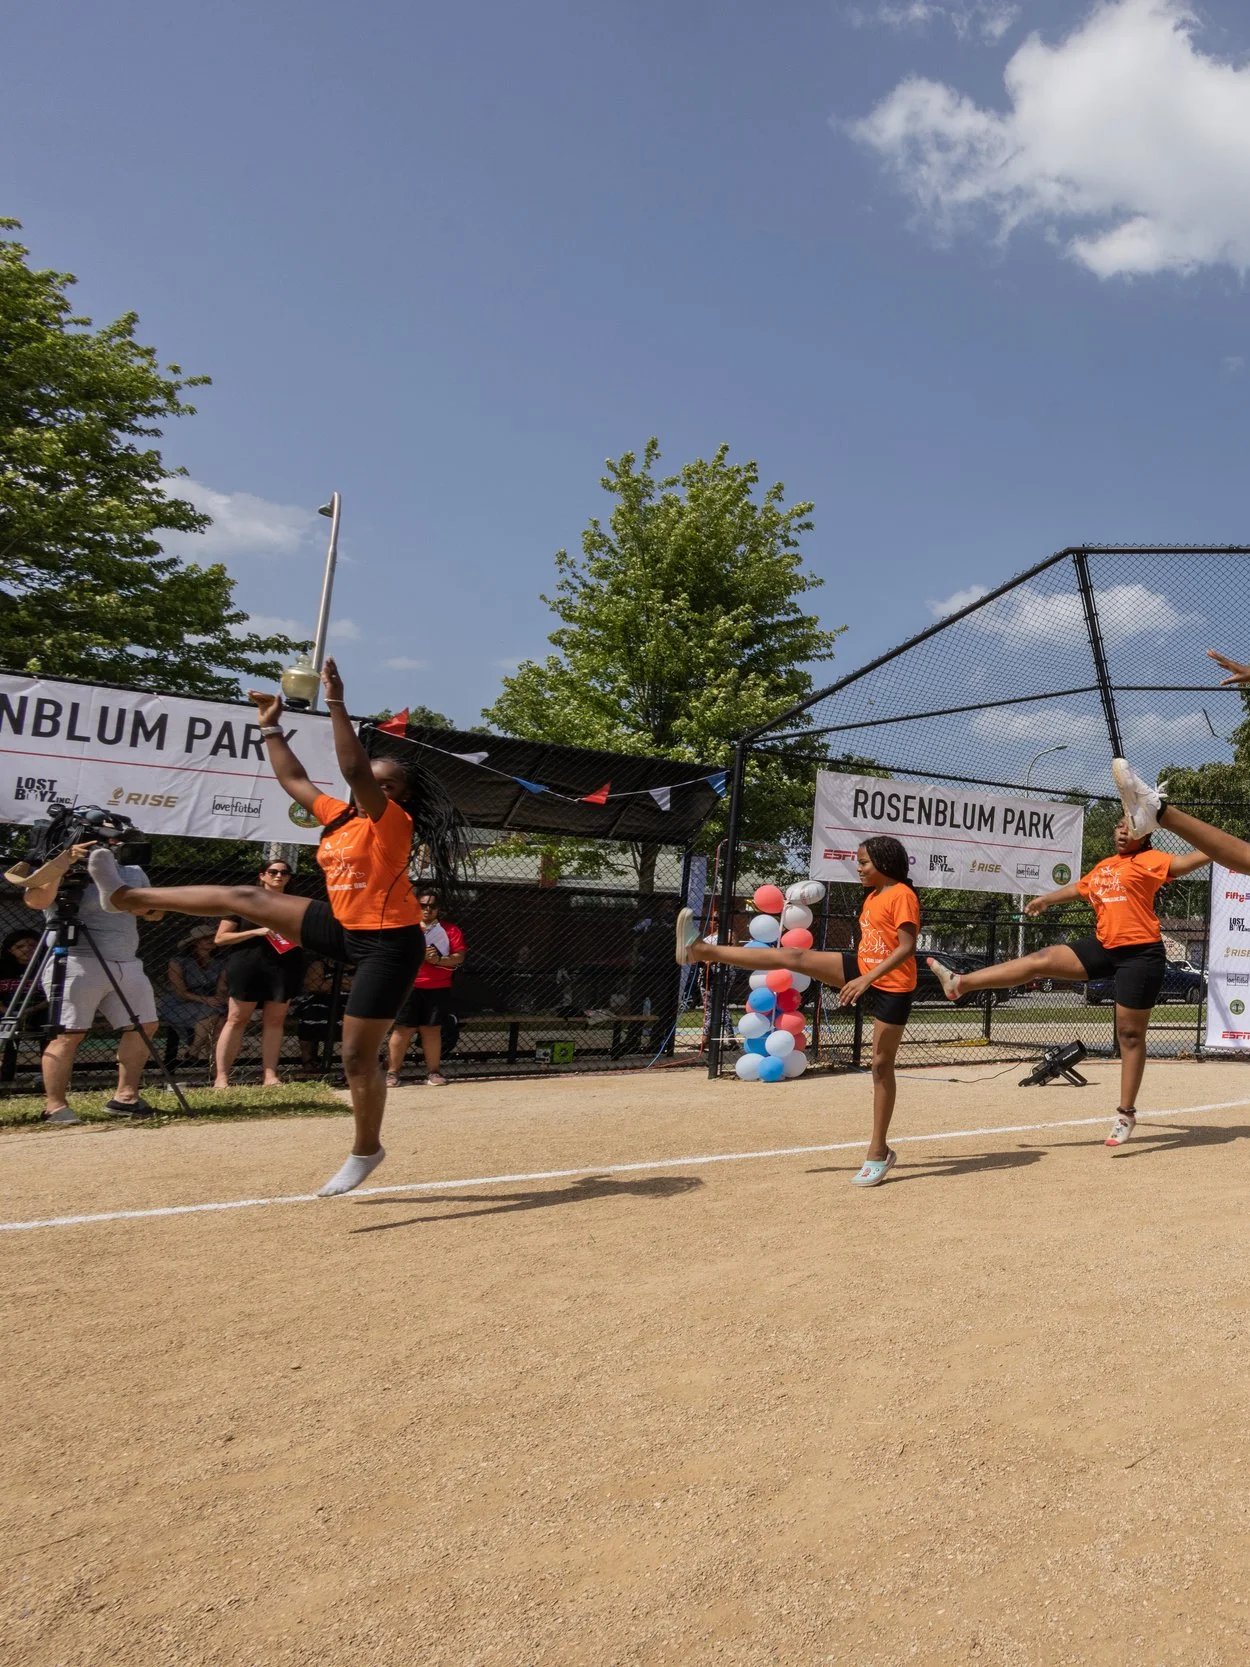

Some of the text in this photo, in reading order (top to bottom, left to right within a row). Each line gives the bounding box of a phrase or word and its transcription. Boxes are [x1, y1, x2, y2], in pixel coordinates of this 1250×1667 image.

[16, 776, 58, 791] LOST
[125, 792, 179, 809] RISE
[213, 799, 231, 812] love
[853, 788, 1055, 840] ROSENBLUM PARK
[930, 854, 948, 864] LOST
[977, 863, 1002, 874] RISE
[1229, 917, 1245, 925] LOST
[1222, 1031, 1250, 1040] ESPN
